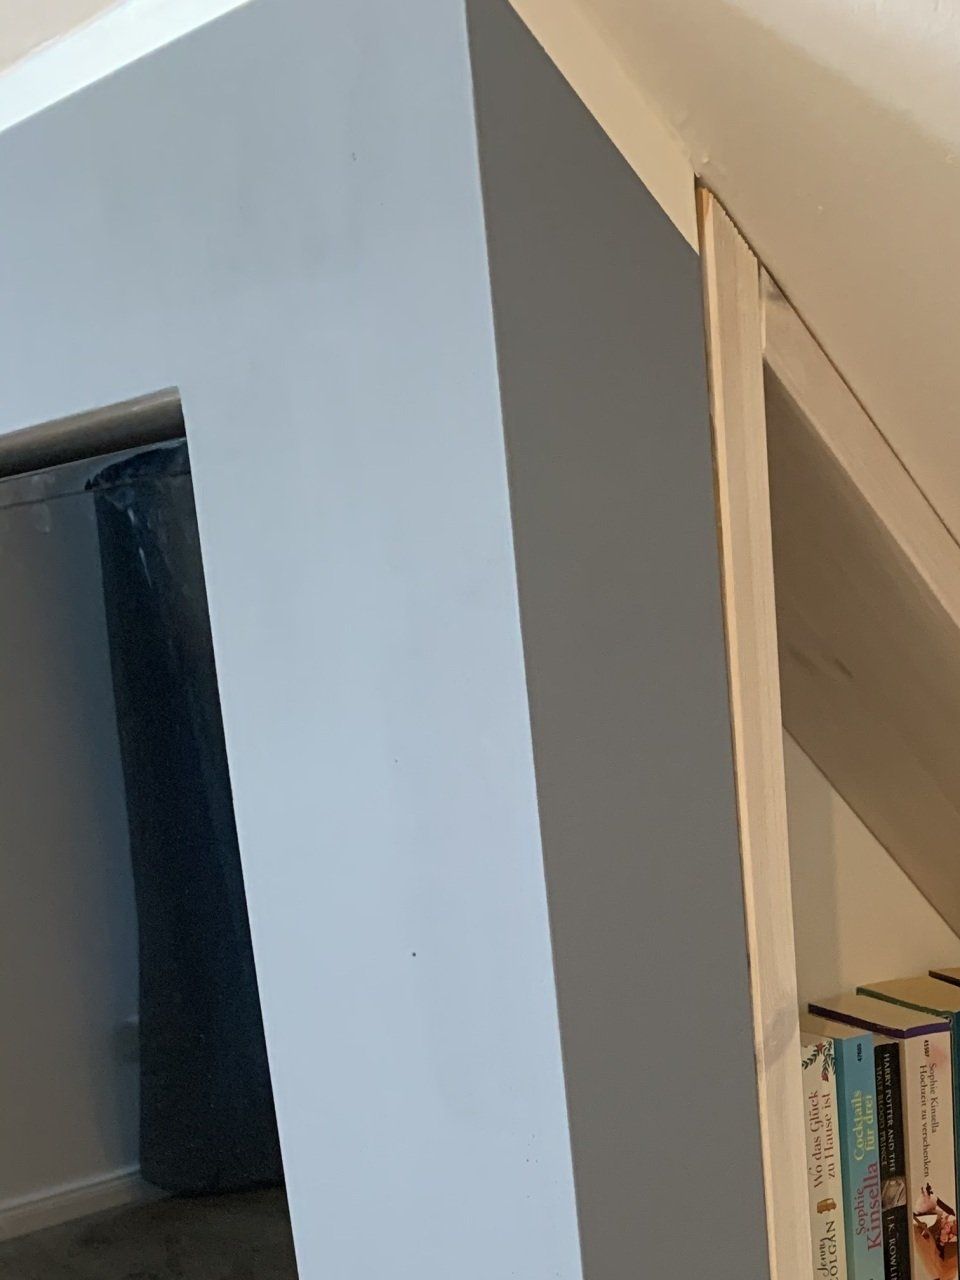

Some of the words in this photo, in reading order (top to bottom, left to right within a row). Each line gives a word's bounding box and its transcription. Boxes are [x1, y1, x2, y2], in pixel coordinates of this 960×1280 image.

[883, 1053, 891, 1087] HARRY
[919, 1064, 928, 1107] Hochzeit
[928, 1062, 937, 1095] Sophie
[808, 1091, 822, 1133] Glück
[822, 1093, 832, 1109] ist
[864, 1095, 874, 1124] drei
[885, 1089, 893, 1126] POTTER
[922, 1109, 928, 1121] zu
[930, 1097, 940, 1134] Kinsella
[823, 1114, 835, 1158] Hause
[851, 1090, 865, 1161] Cocktails
[864, 1130, 875, 1151] für
[887, 1129, 895, 1151] AND
[811, 1137, 822, 1160] das
[922, 1123, 933, 1178] verschenken
[811, 1164, 823, 1189] Wo
[825, 1161, 836, 1182] zu
[854, 1188, 866, 1236] Sophie
[863, 1161, 882, 1251] Kinsella
[817, 1237, 831, 1278] Jenny
